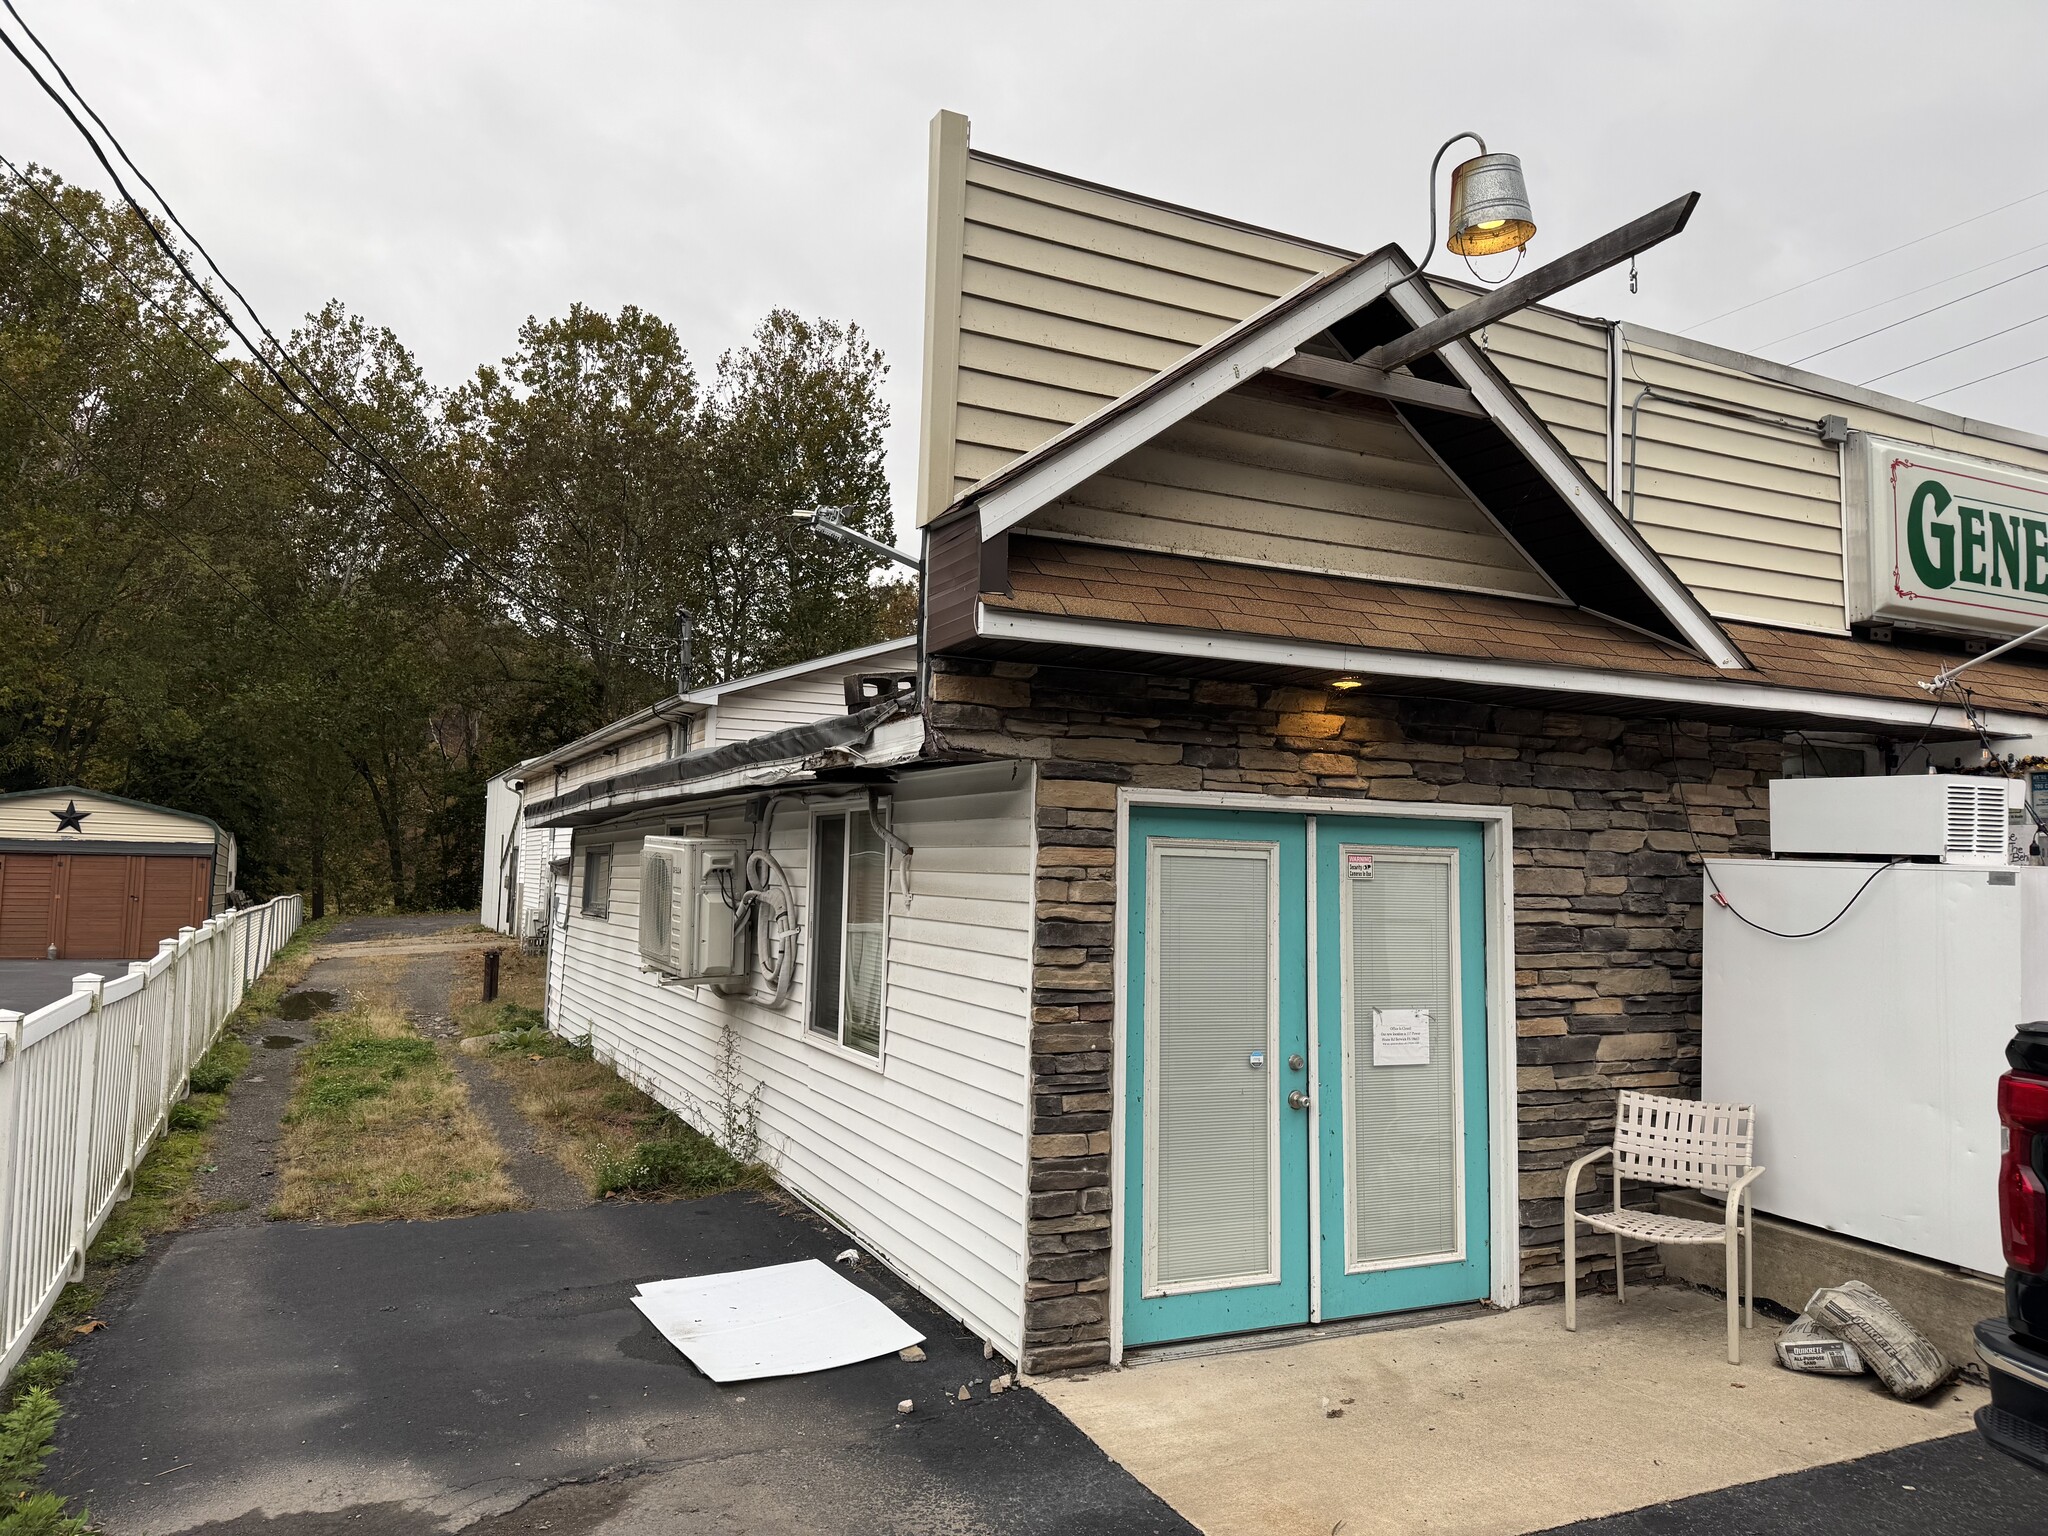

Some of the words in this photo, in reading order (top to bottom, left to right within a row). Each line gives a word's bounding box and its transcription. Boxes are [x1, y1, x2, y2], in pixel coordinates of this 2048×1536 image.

[1907, 480, 2048, 596] GENE
[1793, 1347, 1823, 1355] QUIKRETE
[1851, 1317, 1897, 1356] QUIKRETE
